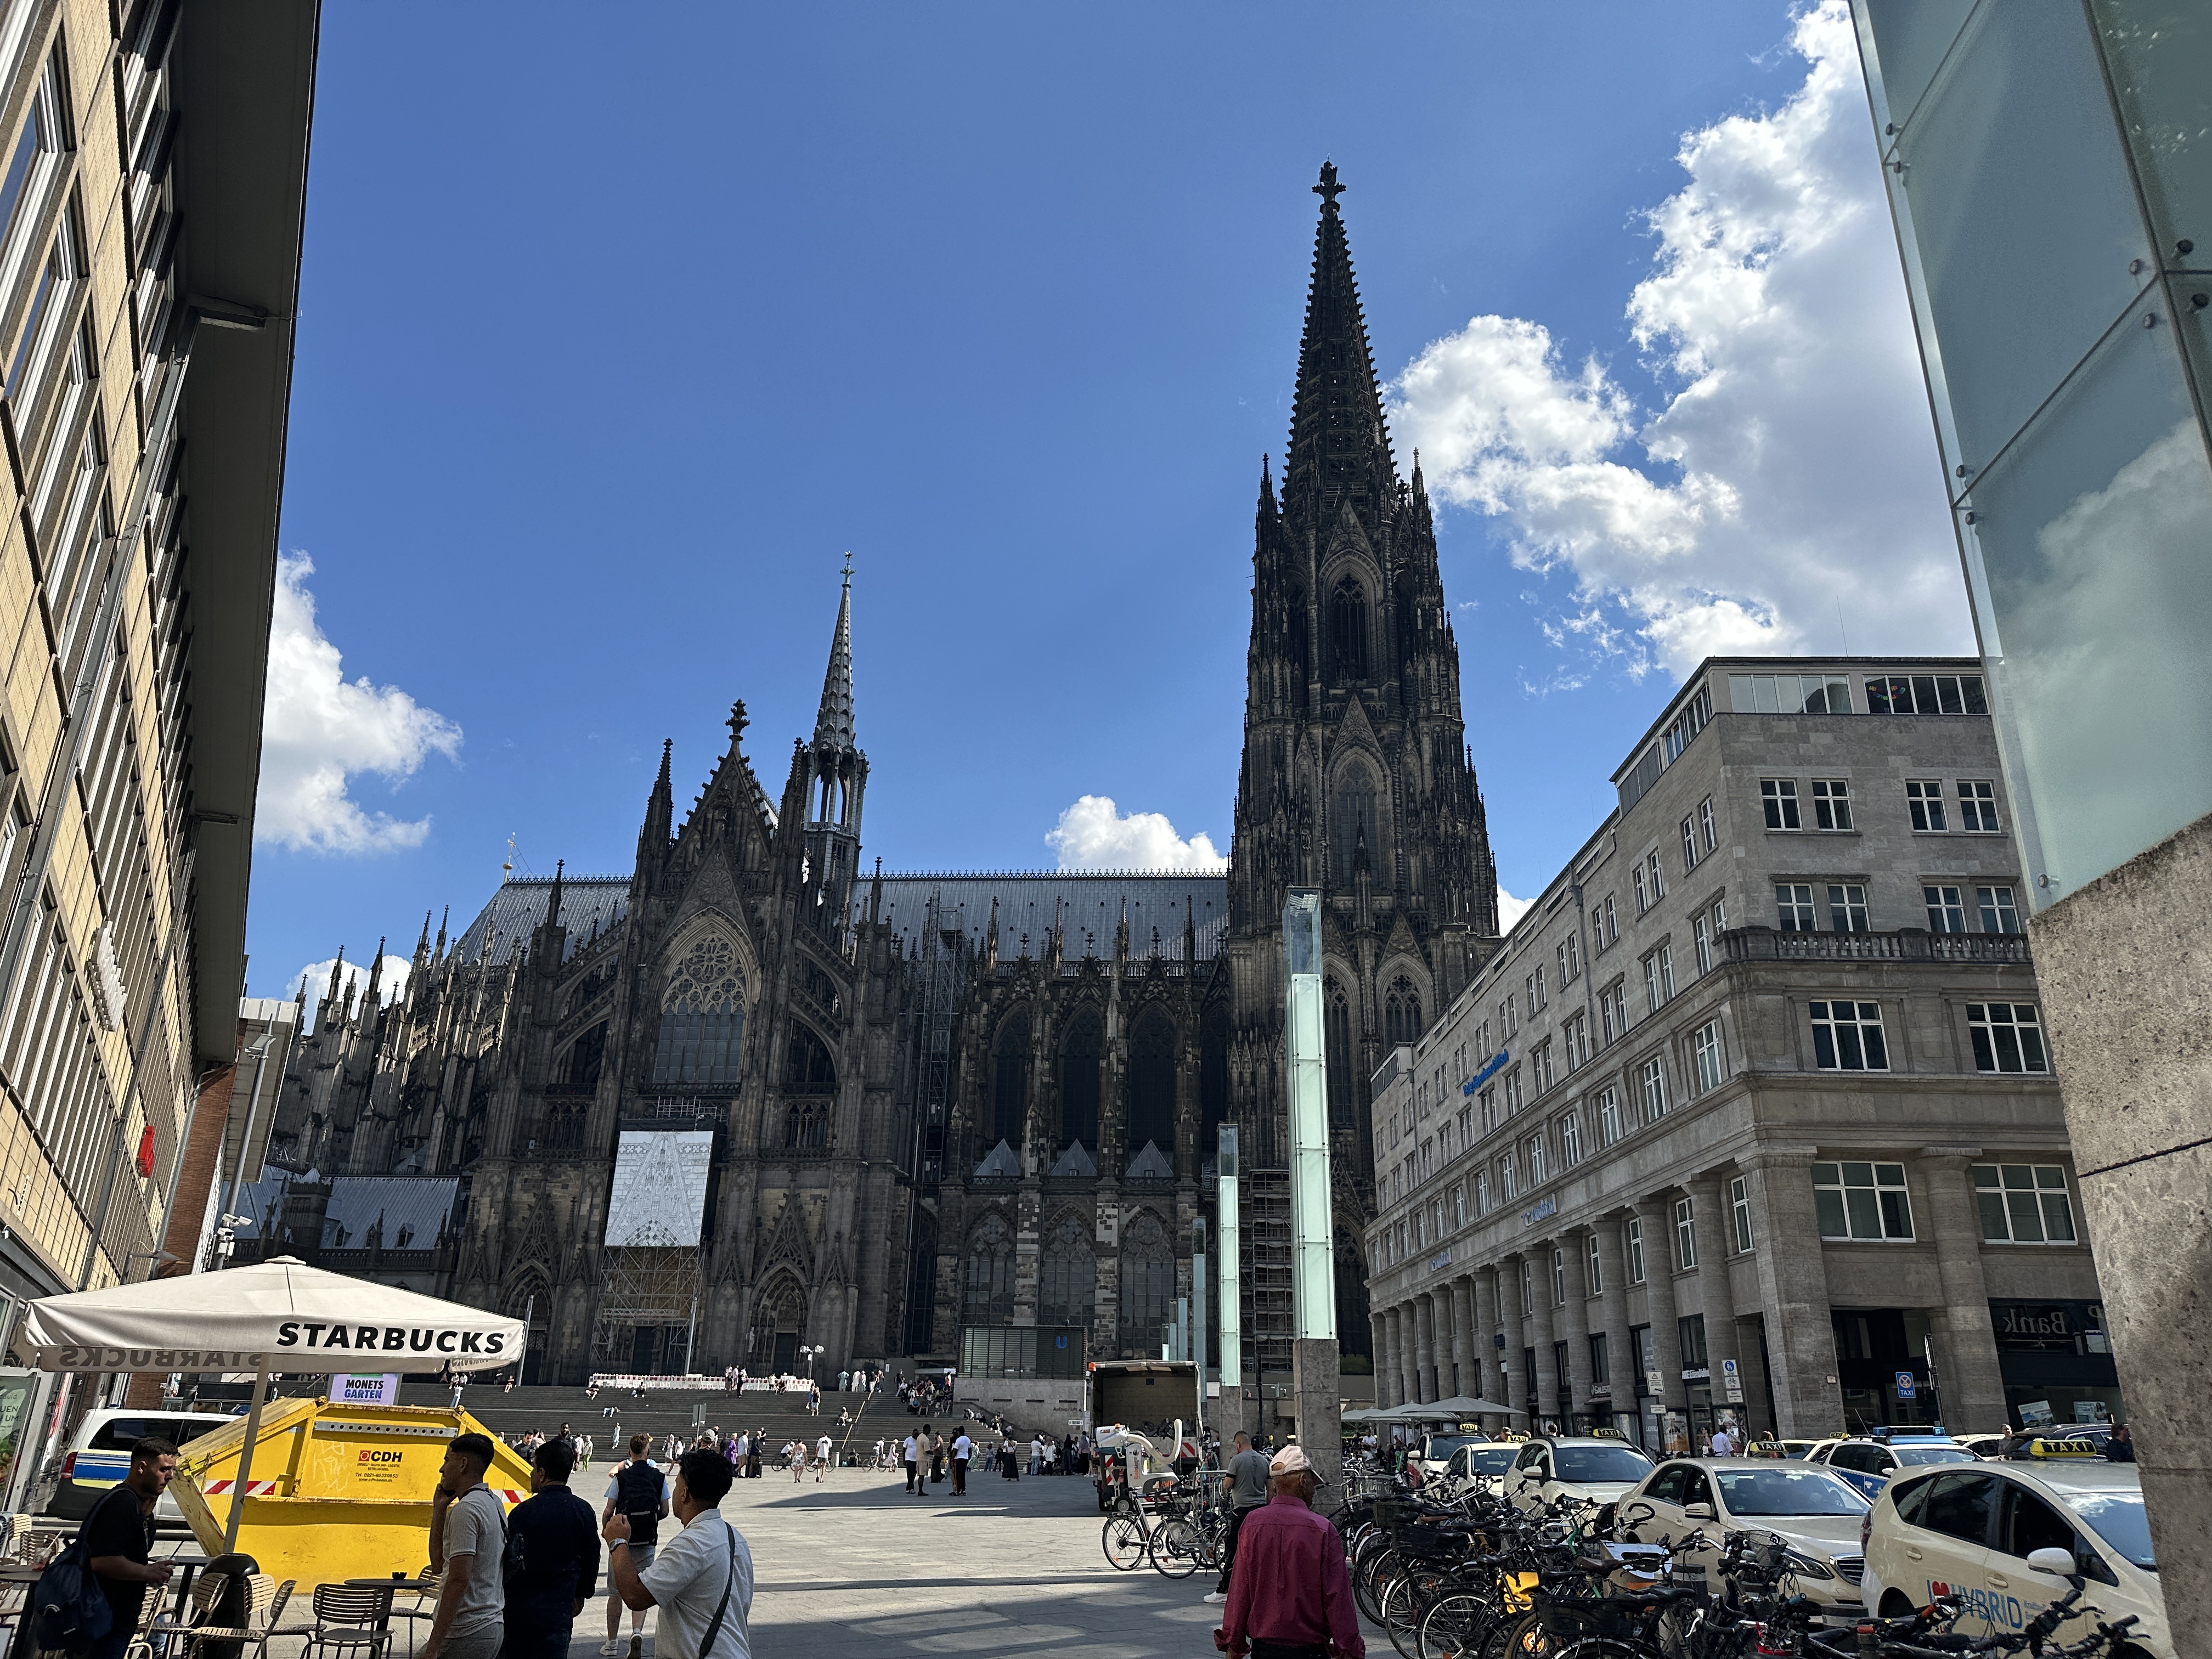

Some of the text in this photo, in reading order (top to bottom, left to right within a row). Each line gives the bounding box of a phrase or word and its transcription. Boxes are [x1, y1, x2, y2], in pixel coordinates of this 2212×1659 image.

[276, 1322, 505, 1353] STARBUCKS
[1056, 1336, 1067, 1349] U
[346, 1379, 384, 1390] MONETS
[345, 1389, 382, 1398] GARTEN
[1759, 1442, 1782, 1451] TAXI
[2047, 1442, 2088, 1452] TAXI
[371, 1451, 403, 1462] CDH
